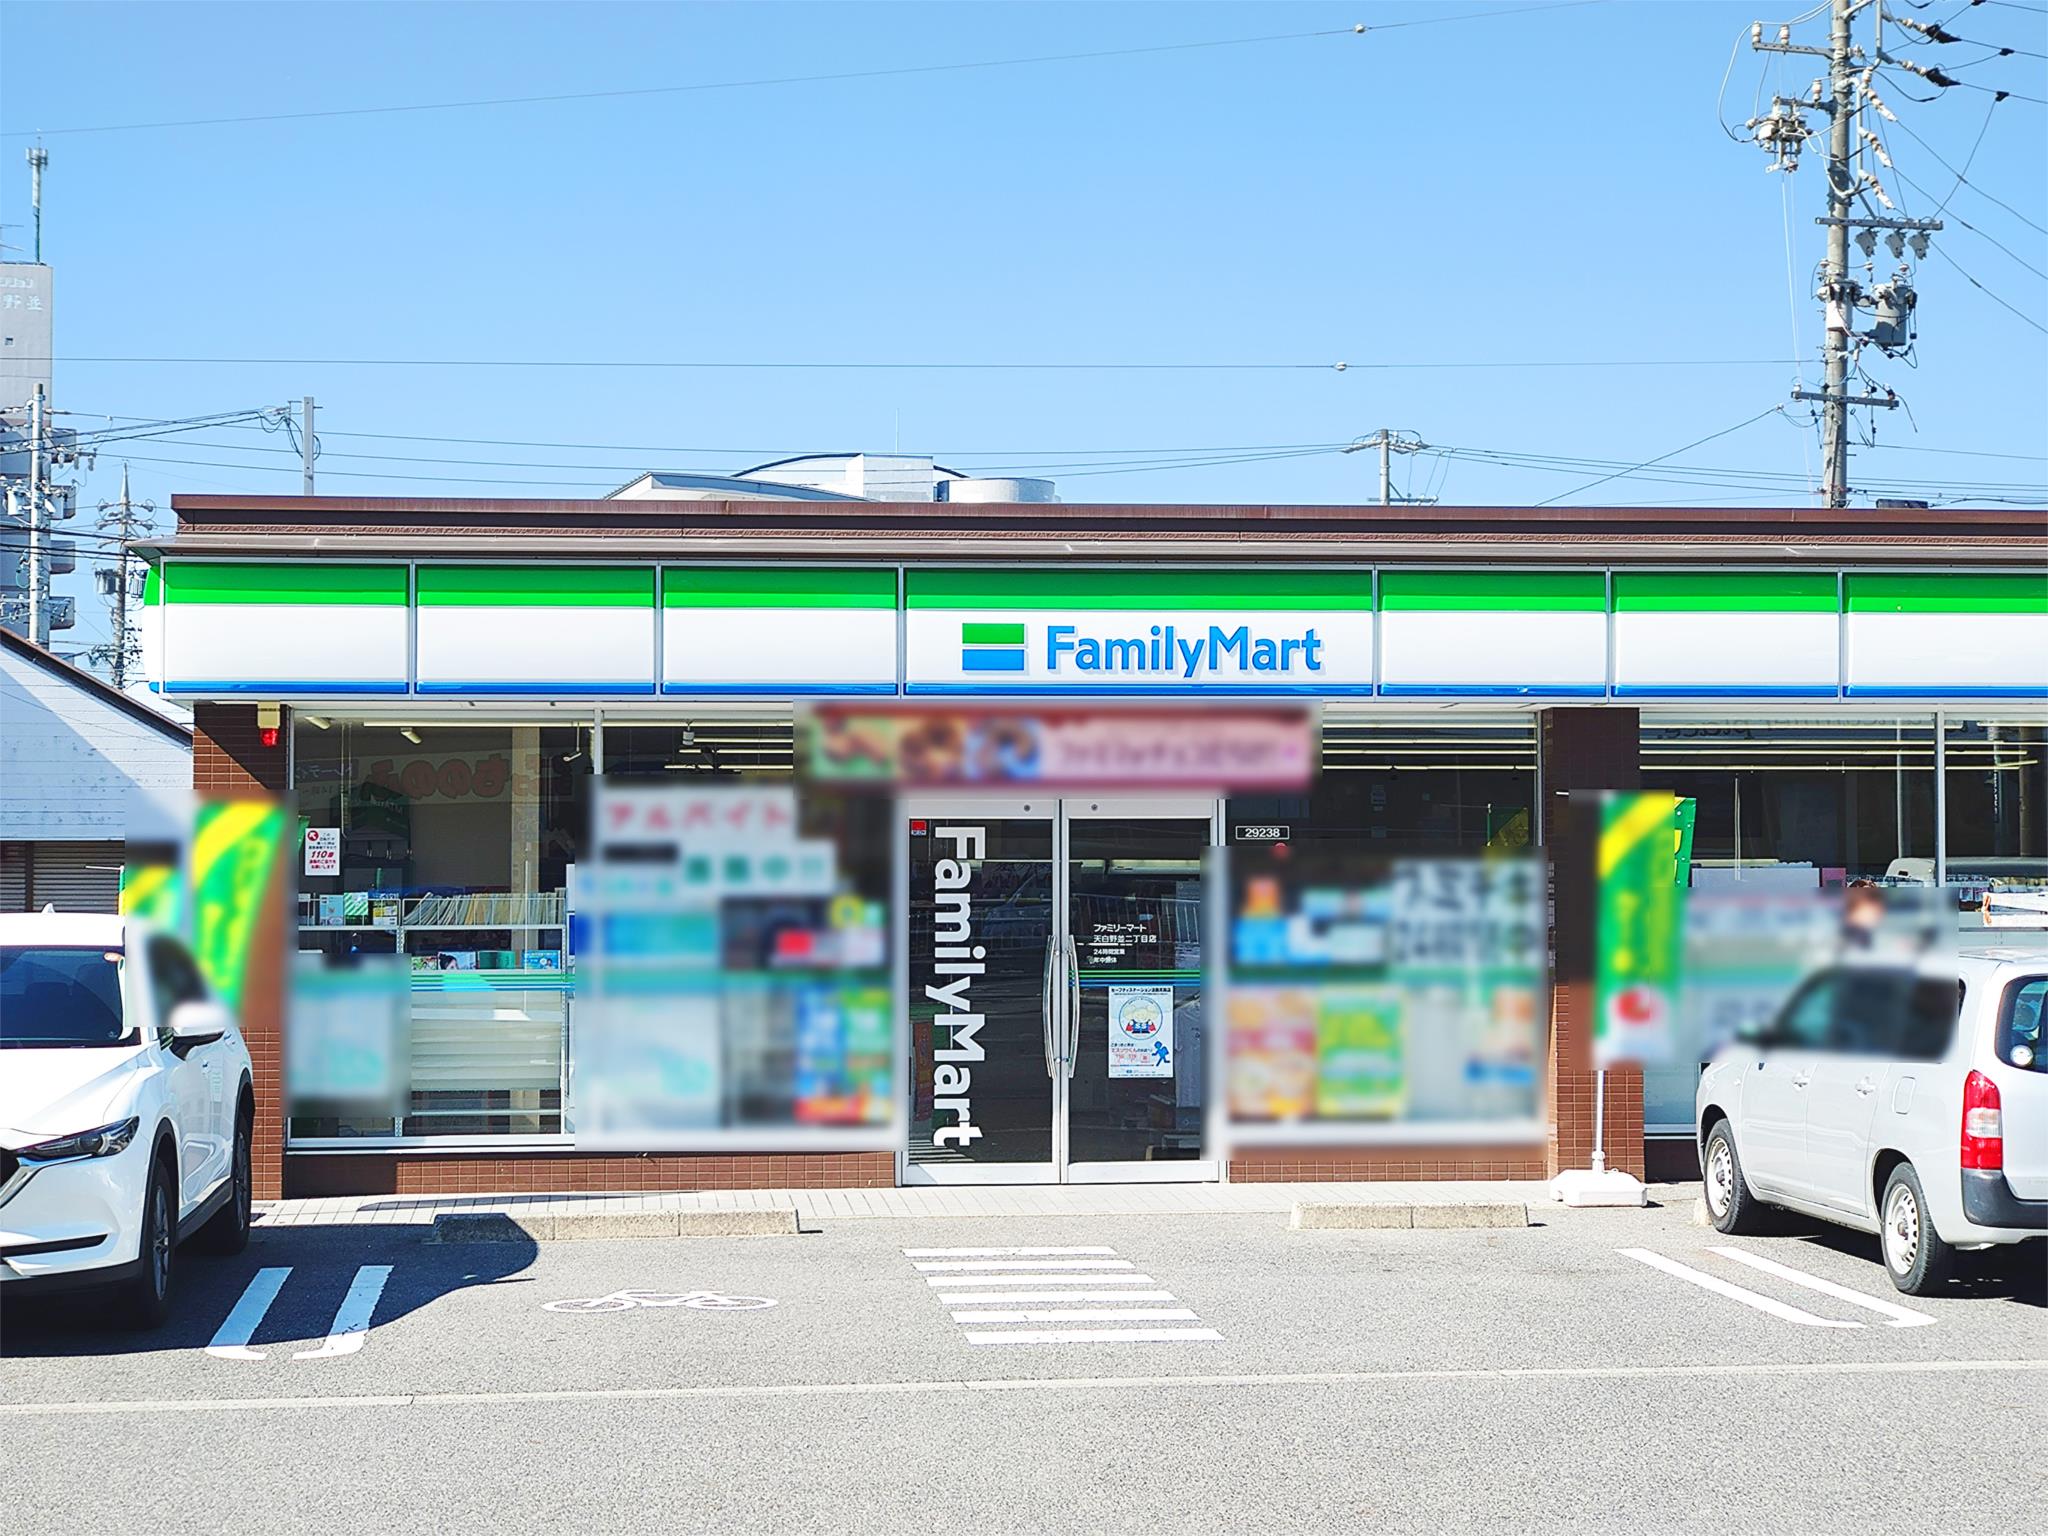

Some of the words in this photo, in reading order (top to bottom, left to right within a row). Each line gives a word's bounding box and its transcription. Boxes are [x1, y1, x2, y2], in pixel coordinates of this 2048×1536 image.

[1046, 625, 1322, 678] FamilyMart
[1245, 828, 1280, 838] 29238
[1093, 924, 1147, 933] ファミリーマート
[1093, 934, 1157, 943] 天白野並二丁目店
[925, 826, 986, 1148] FamilyMart
